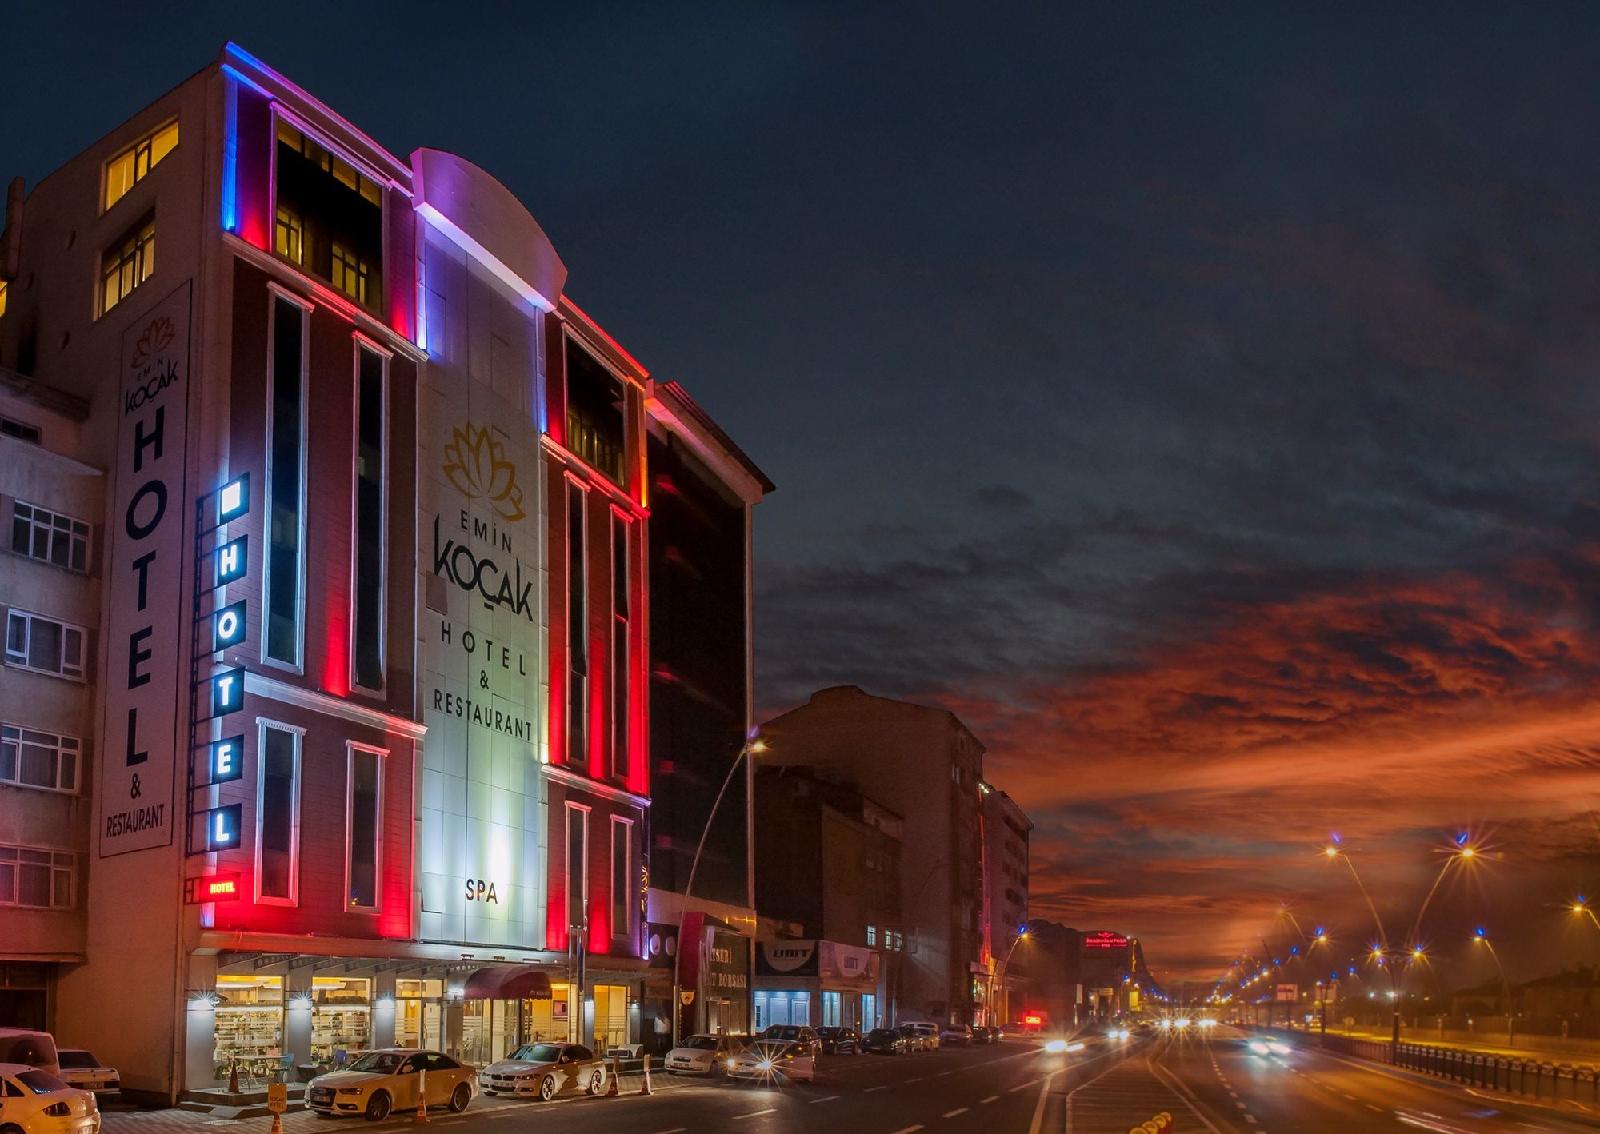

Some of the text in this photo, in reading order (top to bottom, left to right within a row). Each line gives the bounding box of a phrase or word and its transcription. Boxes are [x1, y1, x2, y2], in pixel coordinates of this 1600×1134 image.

[460, 508, 512, 554] EMİN
[125, 404, 168, 768] HOTEL
[433, 512, 533, 622] KOÇAK
[441, 620, 526, 677] HOTEL
[214, 543, 238, 843] HOTEL
[479, 669, 490, 690] &
[433, 688, 532, 742] RESTAURANT
[130, 772, 142, 799] &
[106, 803, 165, 838] RESTAURANT
[209, 881, 236, 895] HOTEL
[465, 878, 498, 905] SPA
